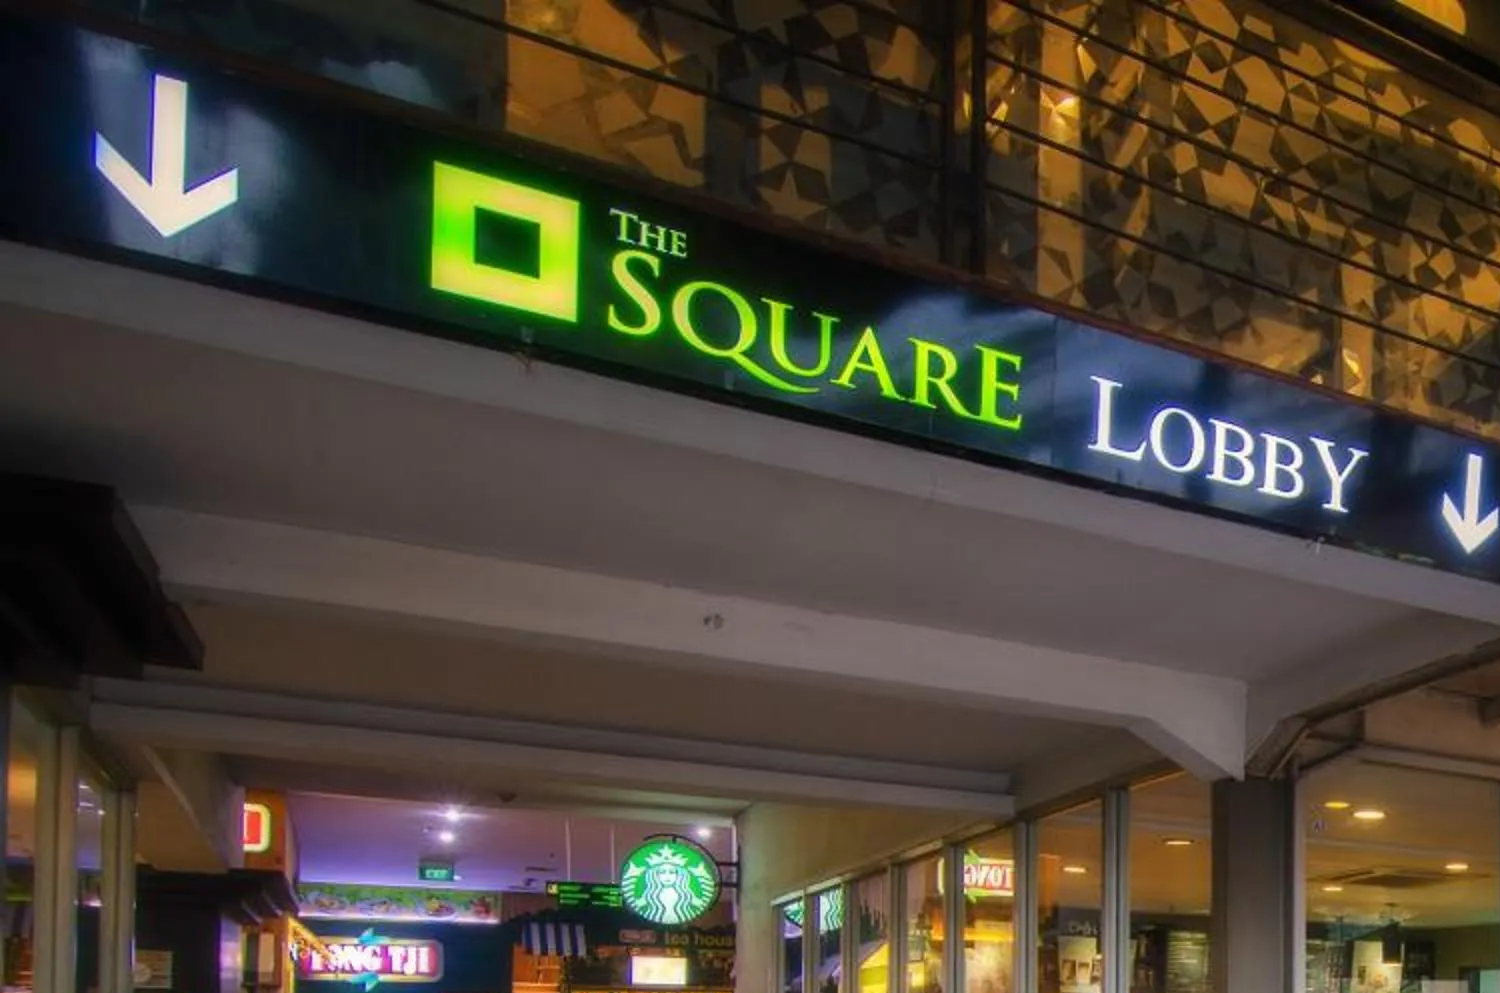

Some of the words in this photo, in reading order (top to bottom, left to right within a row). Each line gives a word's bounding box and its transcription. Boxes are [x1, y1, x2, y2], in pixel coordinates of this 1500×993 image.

[609, 208, 688, 257] THE
[608, 249, 1024, 430] SQUARE
[1087, 375, 1369, 513] LOBBY
